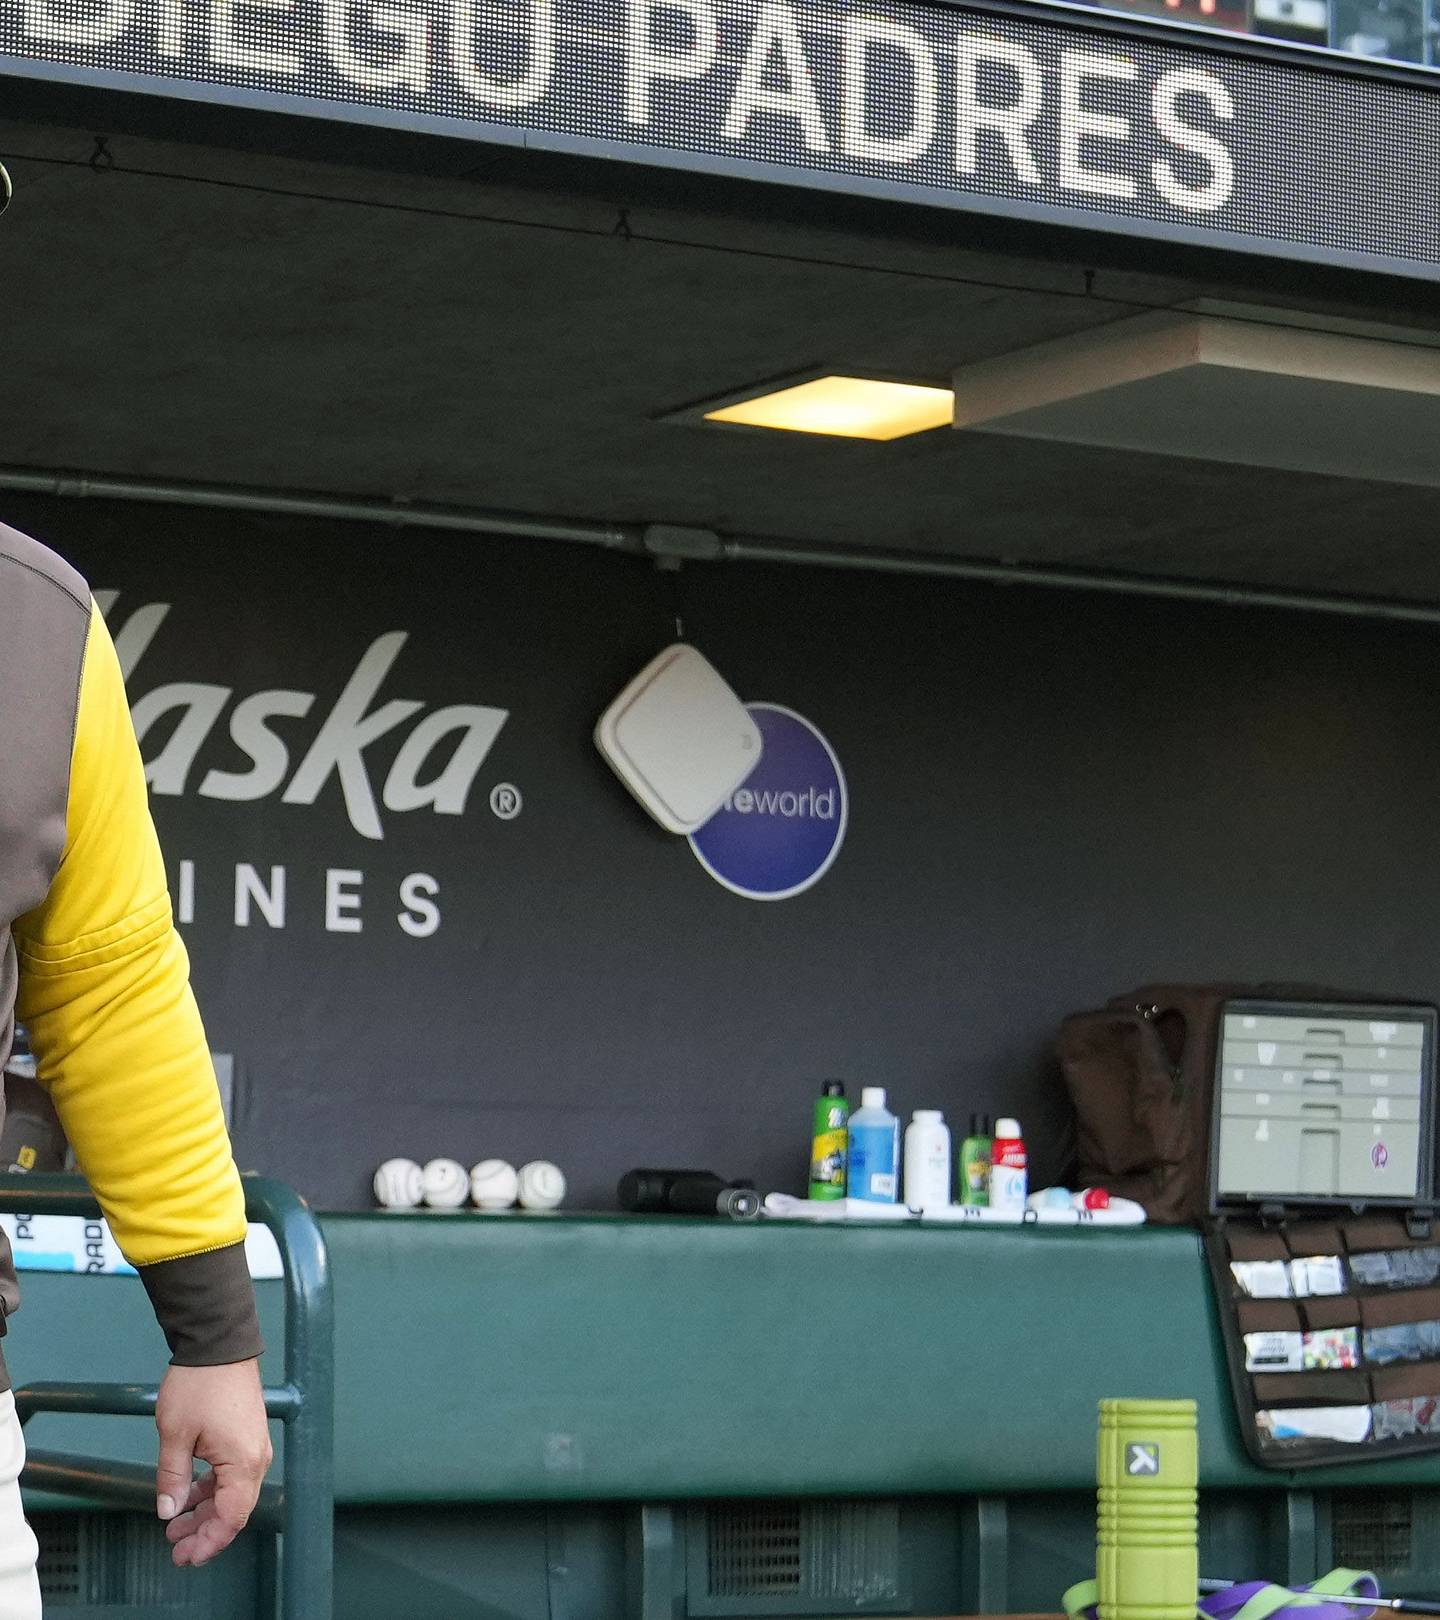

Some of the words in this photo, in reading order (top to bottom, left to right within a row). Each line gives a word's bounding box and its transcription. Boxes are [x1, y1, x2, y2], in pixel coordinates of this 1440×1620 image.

[626, 0, 1236, 212] PADRES
[92, 588, 510, 840] aska
[722, 786, 836, 820] eworld
[178, 859, 441, 938] INES
